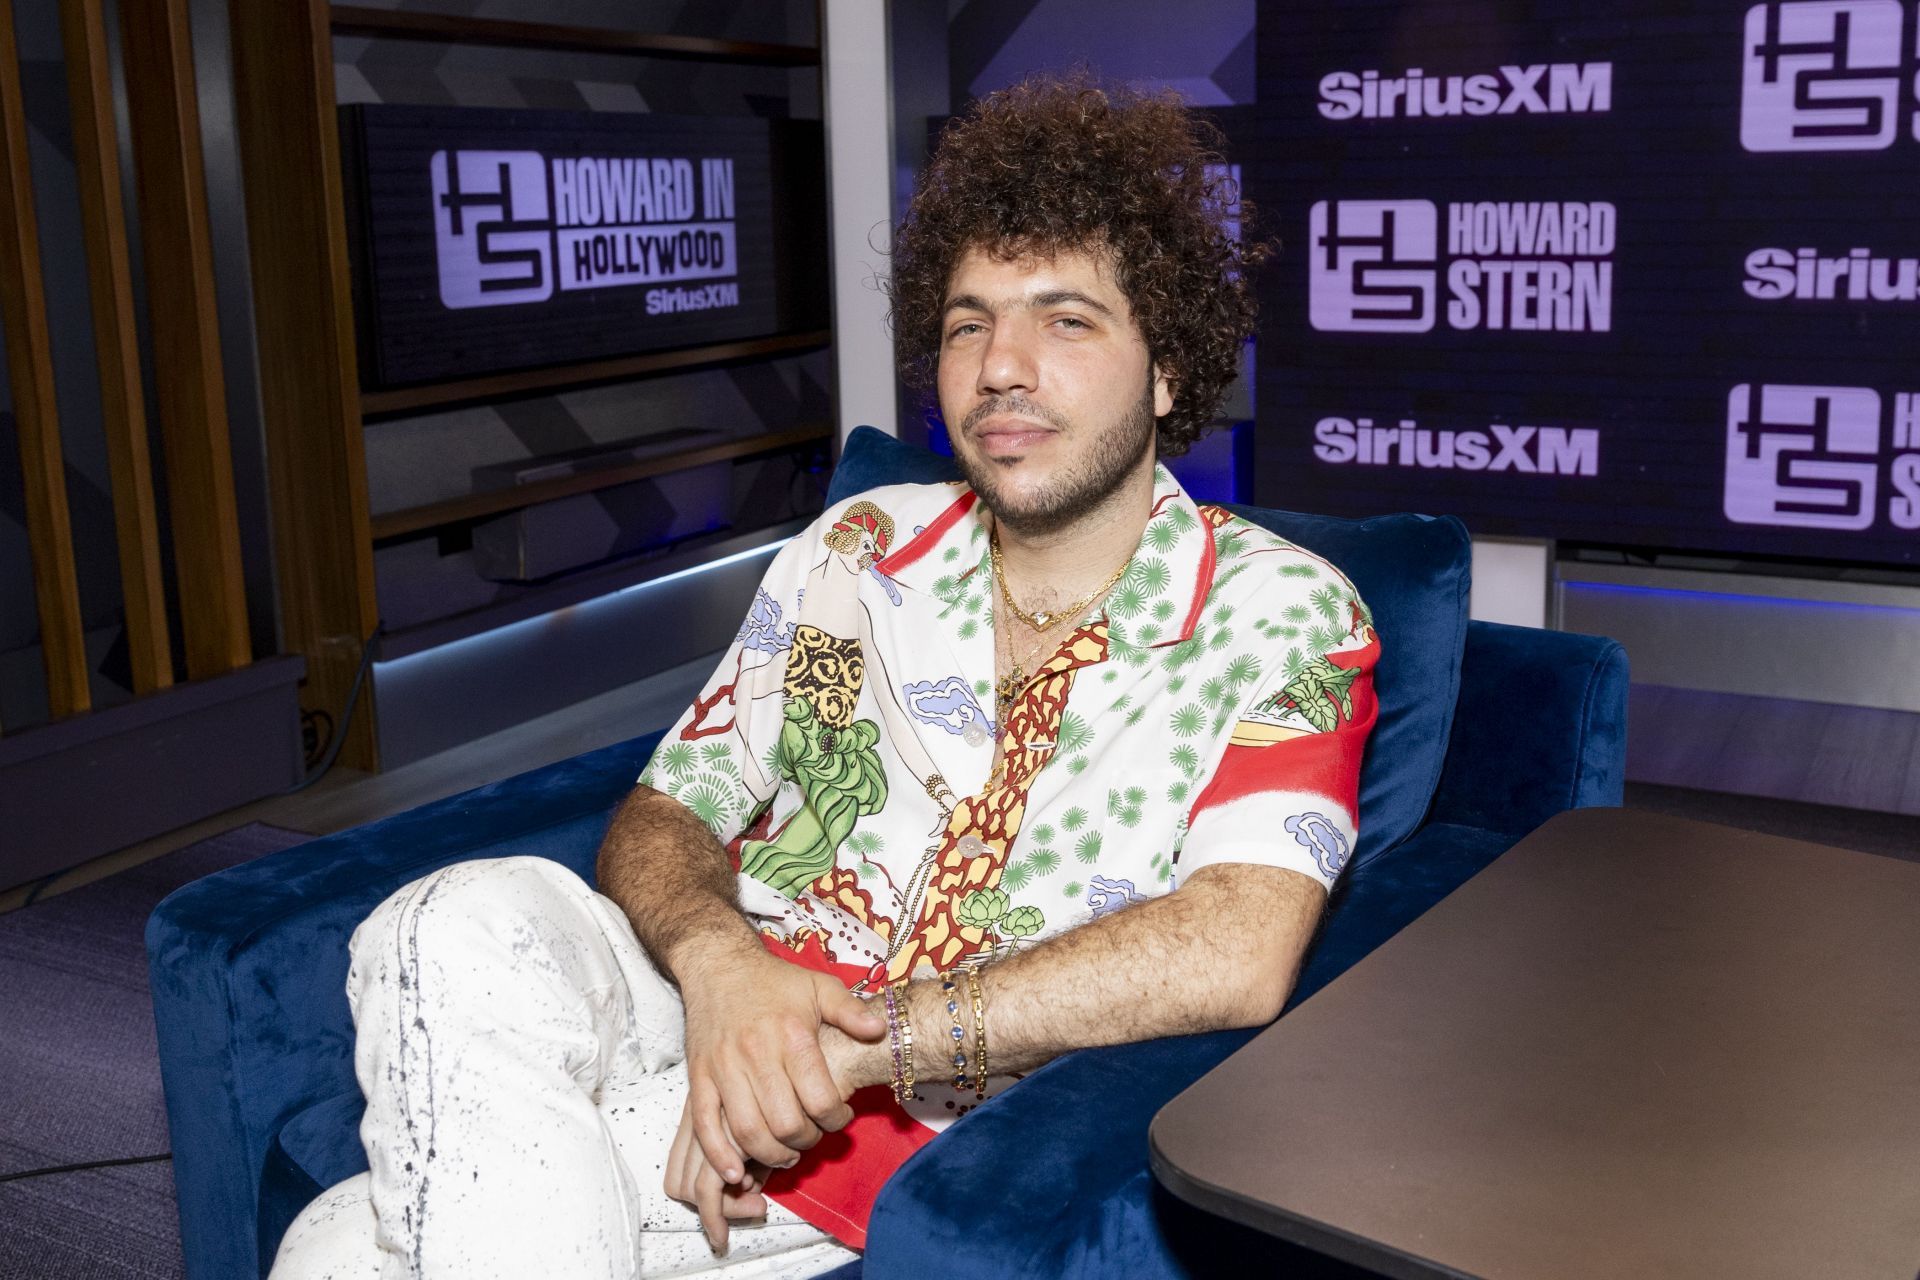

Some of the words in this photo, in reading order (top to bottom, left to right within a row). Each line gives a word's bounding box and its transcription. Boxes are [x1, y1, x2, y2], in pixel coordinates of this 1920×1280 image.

[1318, 62, 1612, 119] SiriusXM
[552, 157, 695, 226] HOWARD
[702, 159, 735, 220] IN
[574, 229, 724, 282] HOLLYWOOD
[1447, 201, 1617, 256] HOWARD
[645, 283, 739, 315] SiriusXM
[1447, 260, 1612, 332] STERN
[1742, 247, 1920, 301] Siriu
[1314, 417, 1598, 476] SiriusXM
